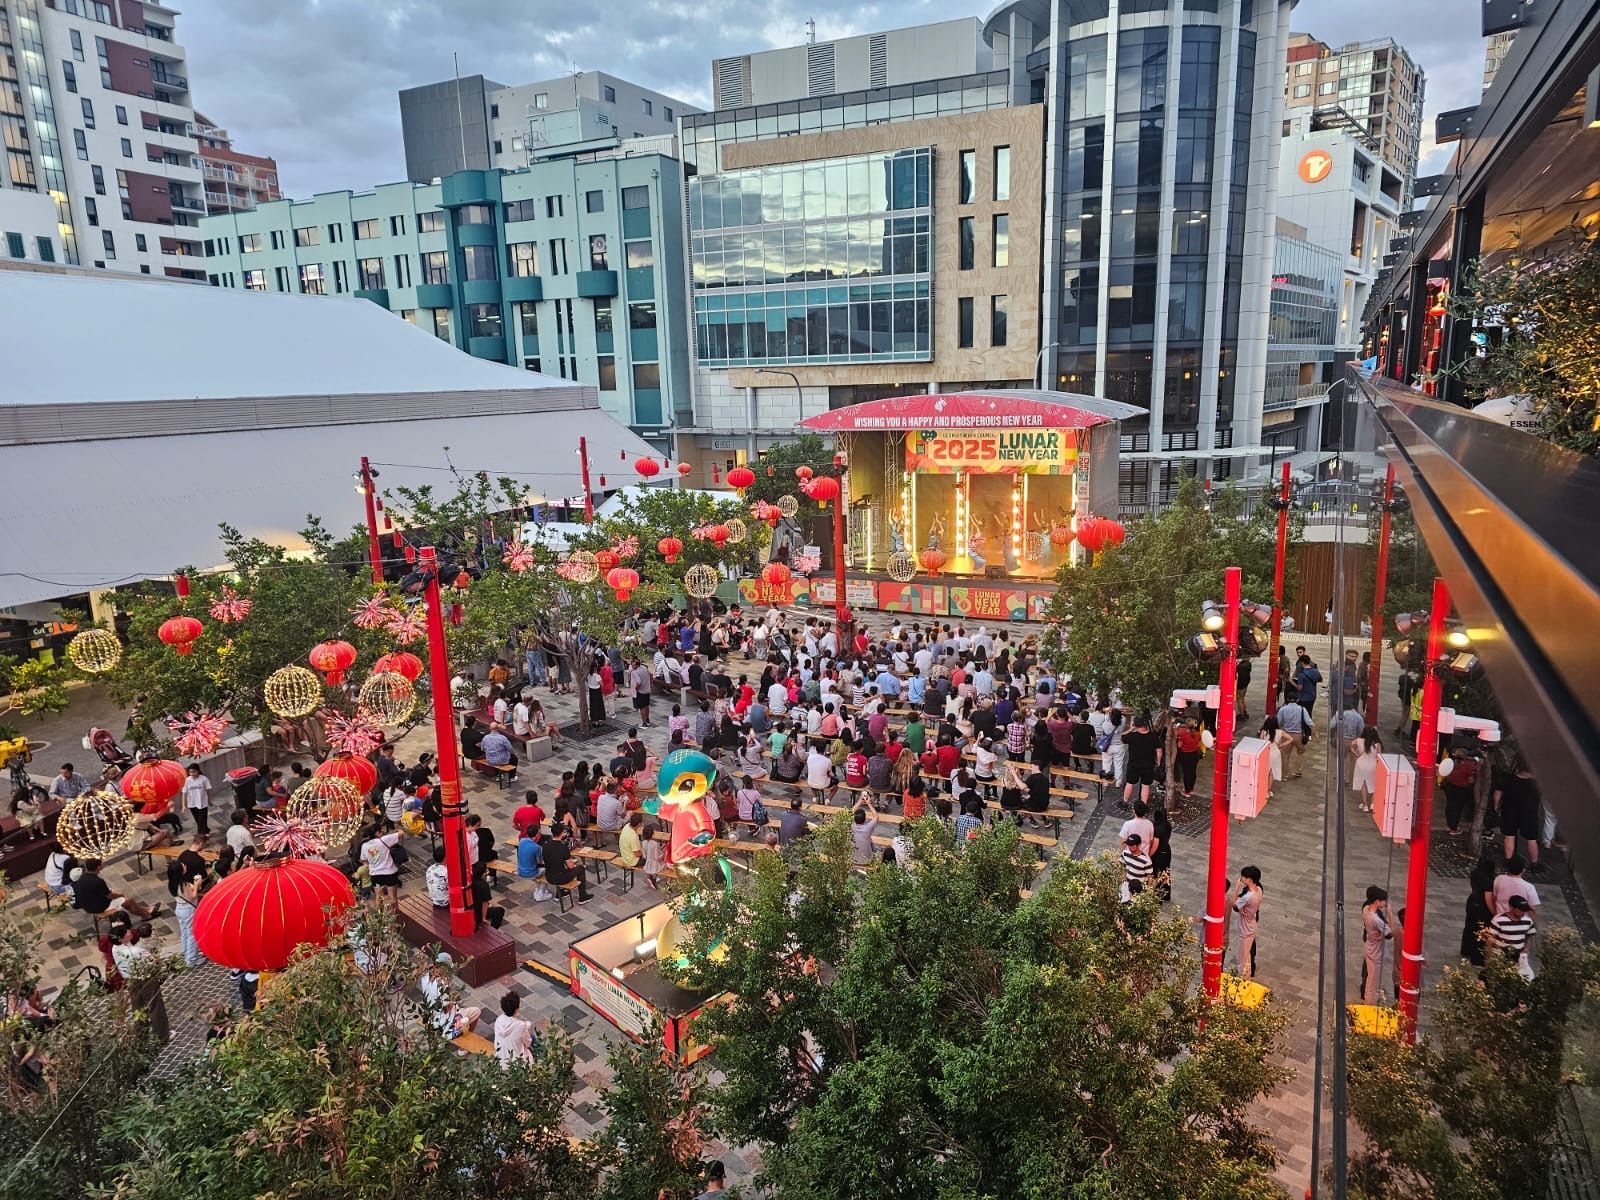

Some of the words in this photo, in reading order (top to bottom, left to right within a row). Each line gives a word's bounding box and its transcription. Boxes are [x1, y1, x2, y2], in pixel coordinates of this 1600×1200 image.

[854, 416, 885, 427] WISHING
[886, 416, 901, 427] YOU
[902, 416, 907, 427] A
[908, 415, 934, 427] HAPPY
[934, 415, 949, 427] AND
[950, 415, 1002, 427] PROSPEROUS
[1002, 415, 1020, 426] NEW
[1021, 415, 1042, 426] YEAR
[999, 432, 1058, 448] LUNAR
[933, 439, 997, 460] 2025
[998, 449, 1024, 460] NEW
[1029, 449, 1058, 460] YEAR
[975, 591, 1000, 599] LUNAR
[975, 598, 1000, 607] NEW
[975, 607, 1000, 616] YEAR
